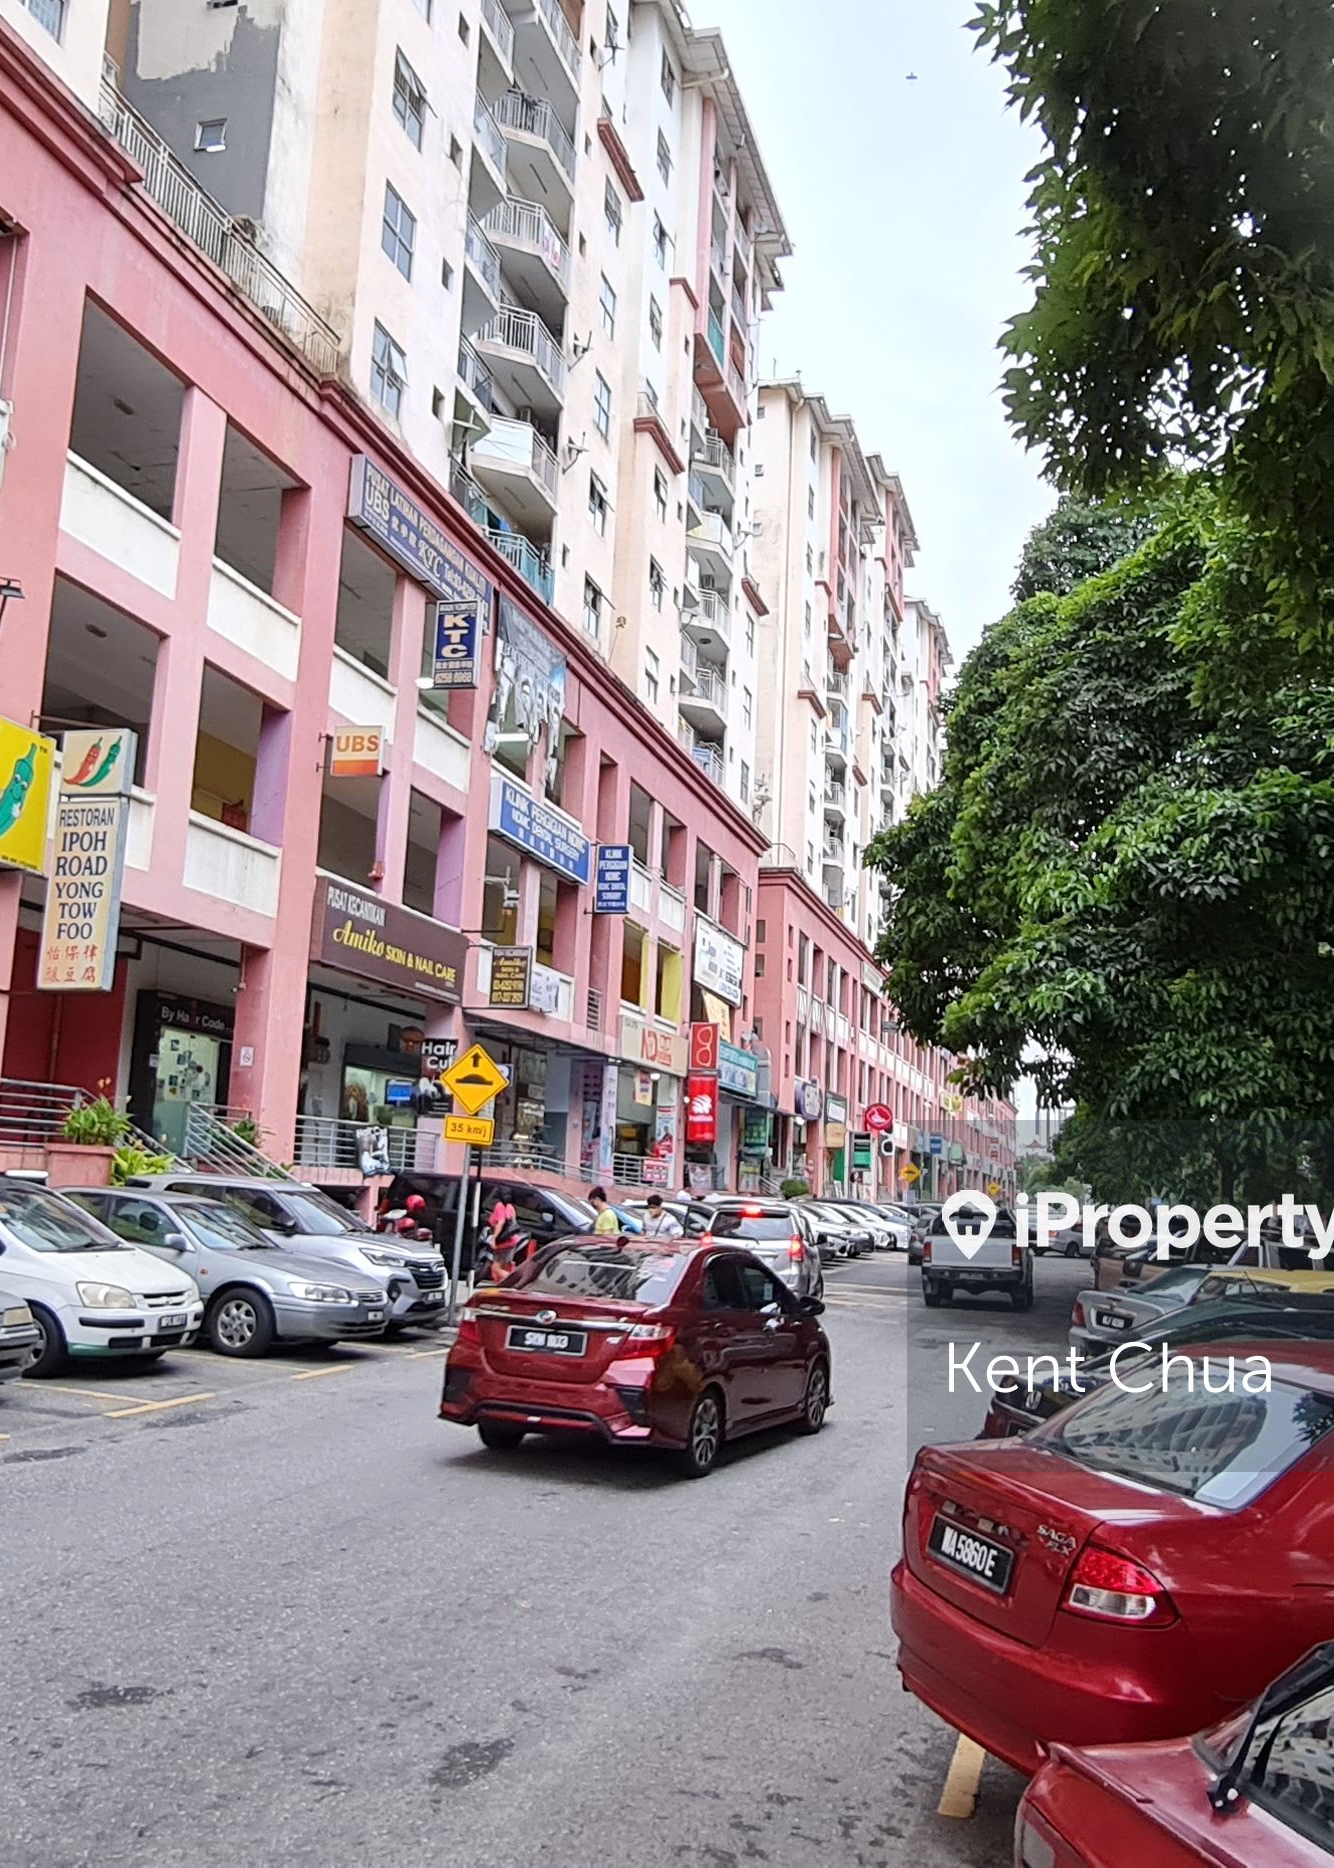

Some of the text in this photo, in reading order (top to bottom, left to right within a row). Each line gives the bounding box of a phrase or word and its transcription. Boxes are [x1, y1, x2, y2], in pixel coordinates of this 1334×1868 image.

[366, 481, 391, 522] UBS
[442, 614, 470, 658] KTC
[336, 735, 379, 752] UBS
[506, 786, 529, 816] KLINIK
[59, 807, 115, 828] RESTORAN
[61, 831, 107, 852] IPOH
[55, 856, 108, 876] ROAD
[55, 882, 104, 899] YONG
[58, 903, 97, 919] TOW
[327, 886, 386, 927] PUSAT KECANTIKAN
[56, 923, 93, 940] FOO
[333, 920, 456, 982] Amiko SKIN & NAIL CARE
[161, 1006, 175, 1022] By
[201, 1015, 225, 1030] Code
[421, 1041, 457, 1055] Hair
[451, 1122, 464, 1132] 35
[1037, 1523, 1077, 1550] SAGA
[1046, 1540, 1073, 1557] FLX
